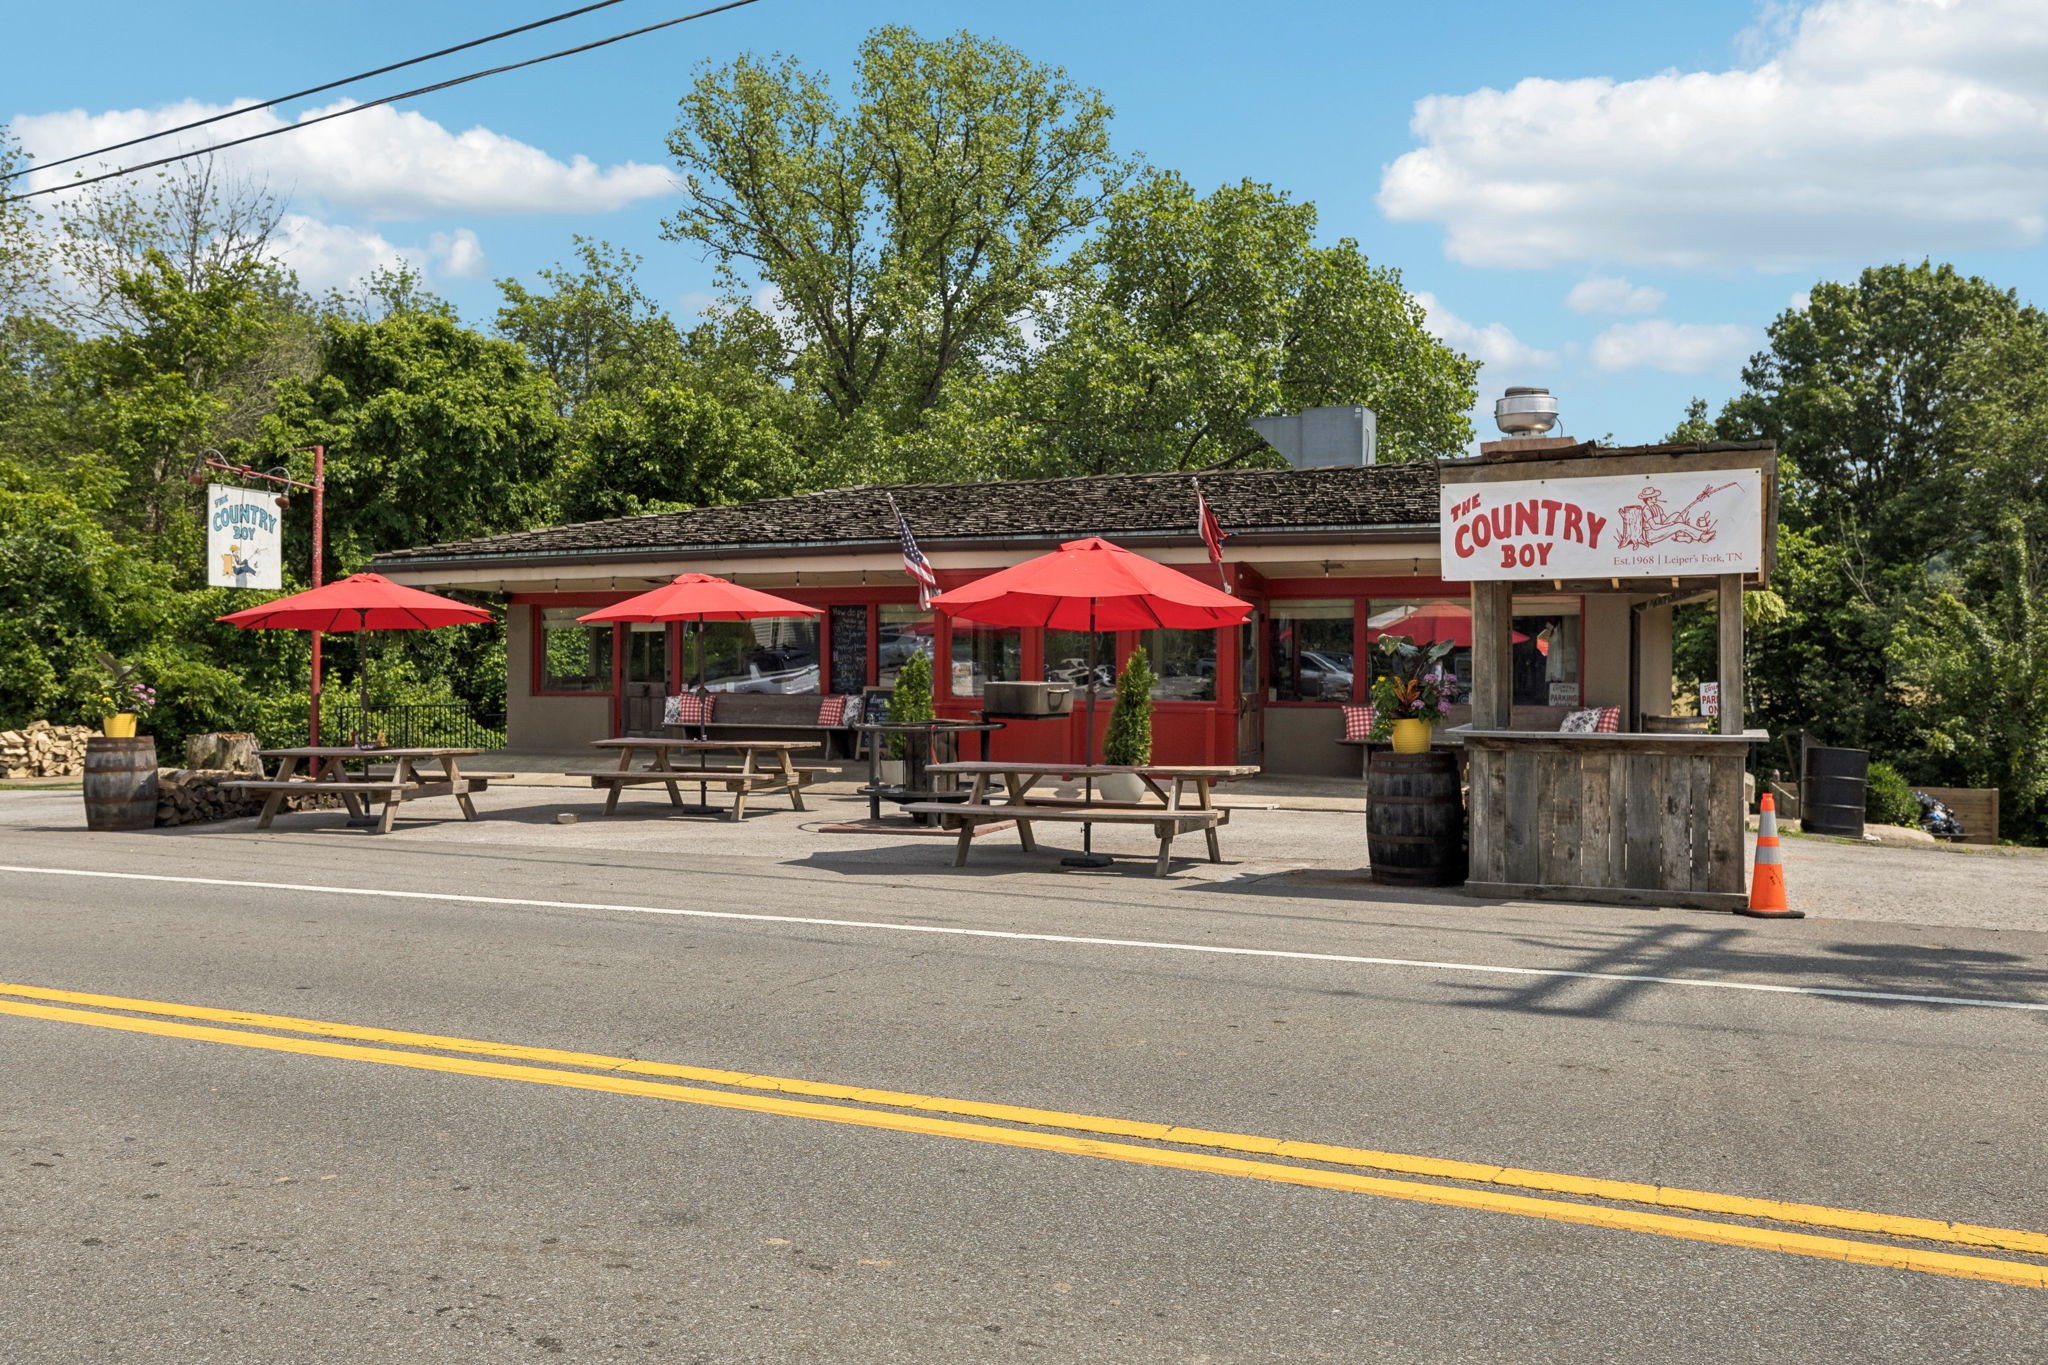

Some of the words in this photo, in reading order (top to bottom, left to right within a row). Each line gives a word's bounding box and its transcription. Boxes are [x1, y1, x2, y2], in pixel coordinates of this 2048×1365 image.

[212, 503, 277, 534] COUNTRY
[1450, 492, 1481, 523] THE
[232, 525, 256, 541] BOY
[1454, 499, 1607, 559] COUNTRY
[1500, 542, 1554, 569] BOY
[1632, 555, 1655, 566] 1968
[1664, 554, 1699, 566] Leiper's
[1701, 553, 1725, 563] Fork,
[1726, 552, 1743, 562] TN
[1702, 695, 1719, 705] PAR
